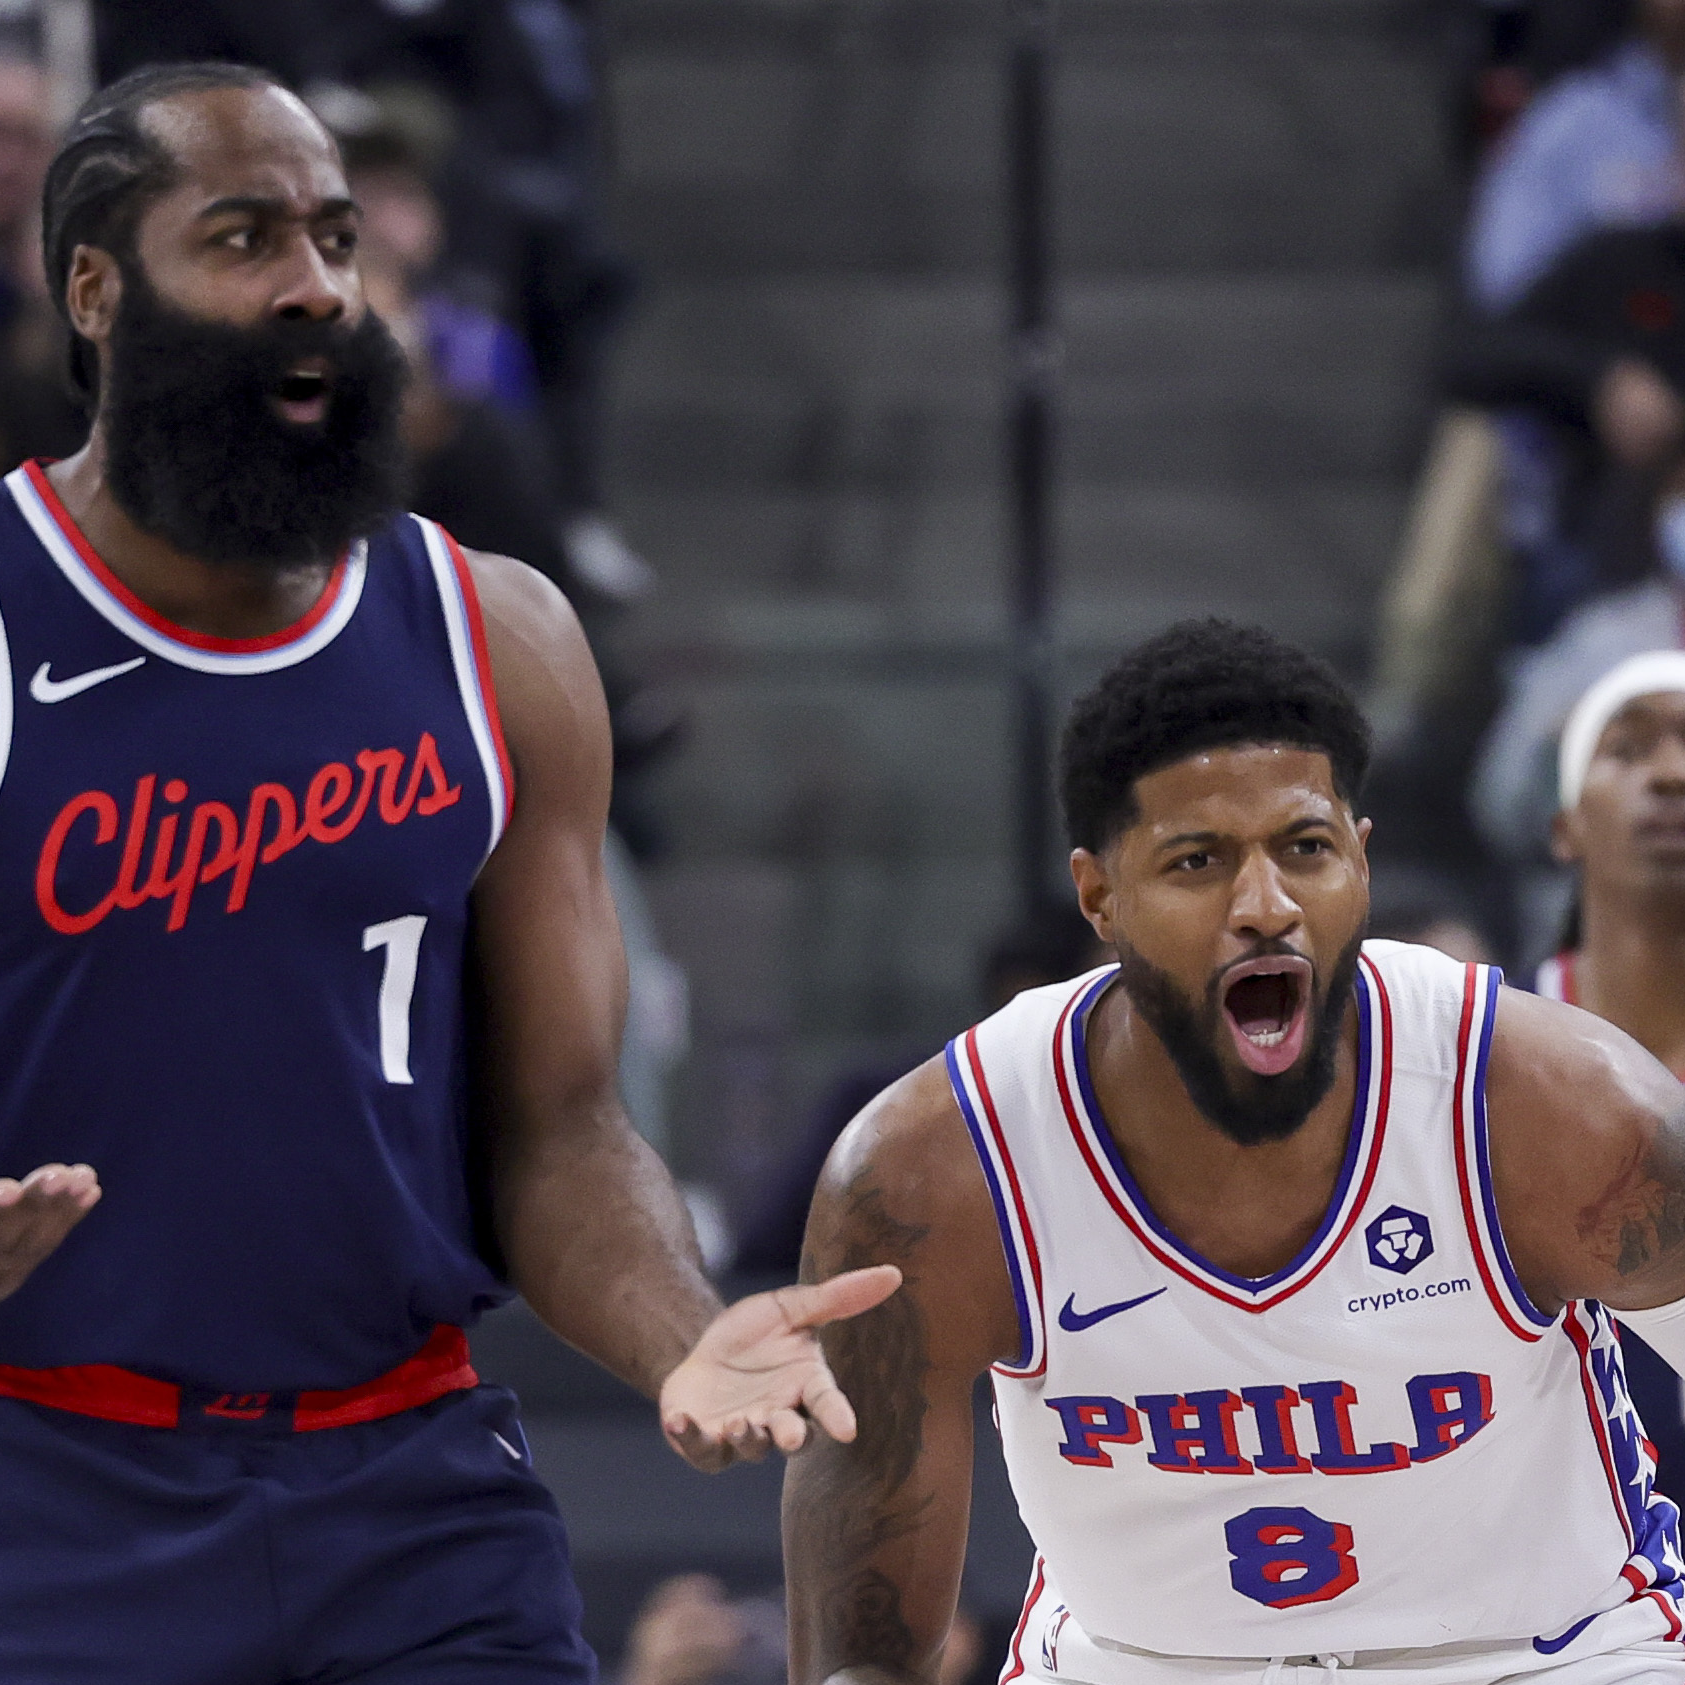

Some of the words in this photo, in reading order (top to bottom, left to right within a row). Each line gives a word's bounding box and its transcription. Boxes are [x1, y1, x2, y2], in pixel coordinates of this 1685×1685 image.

[35, 731, 462, 935] Clippers
[362, 914, 428, 1085] 1
[1347, 1278, 1472, 1312] crypto.com
[1044, 1371, 1496, 1476] PHILA
[1224, 1506, 1360, 1610] 8
